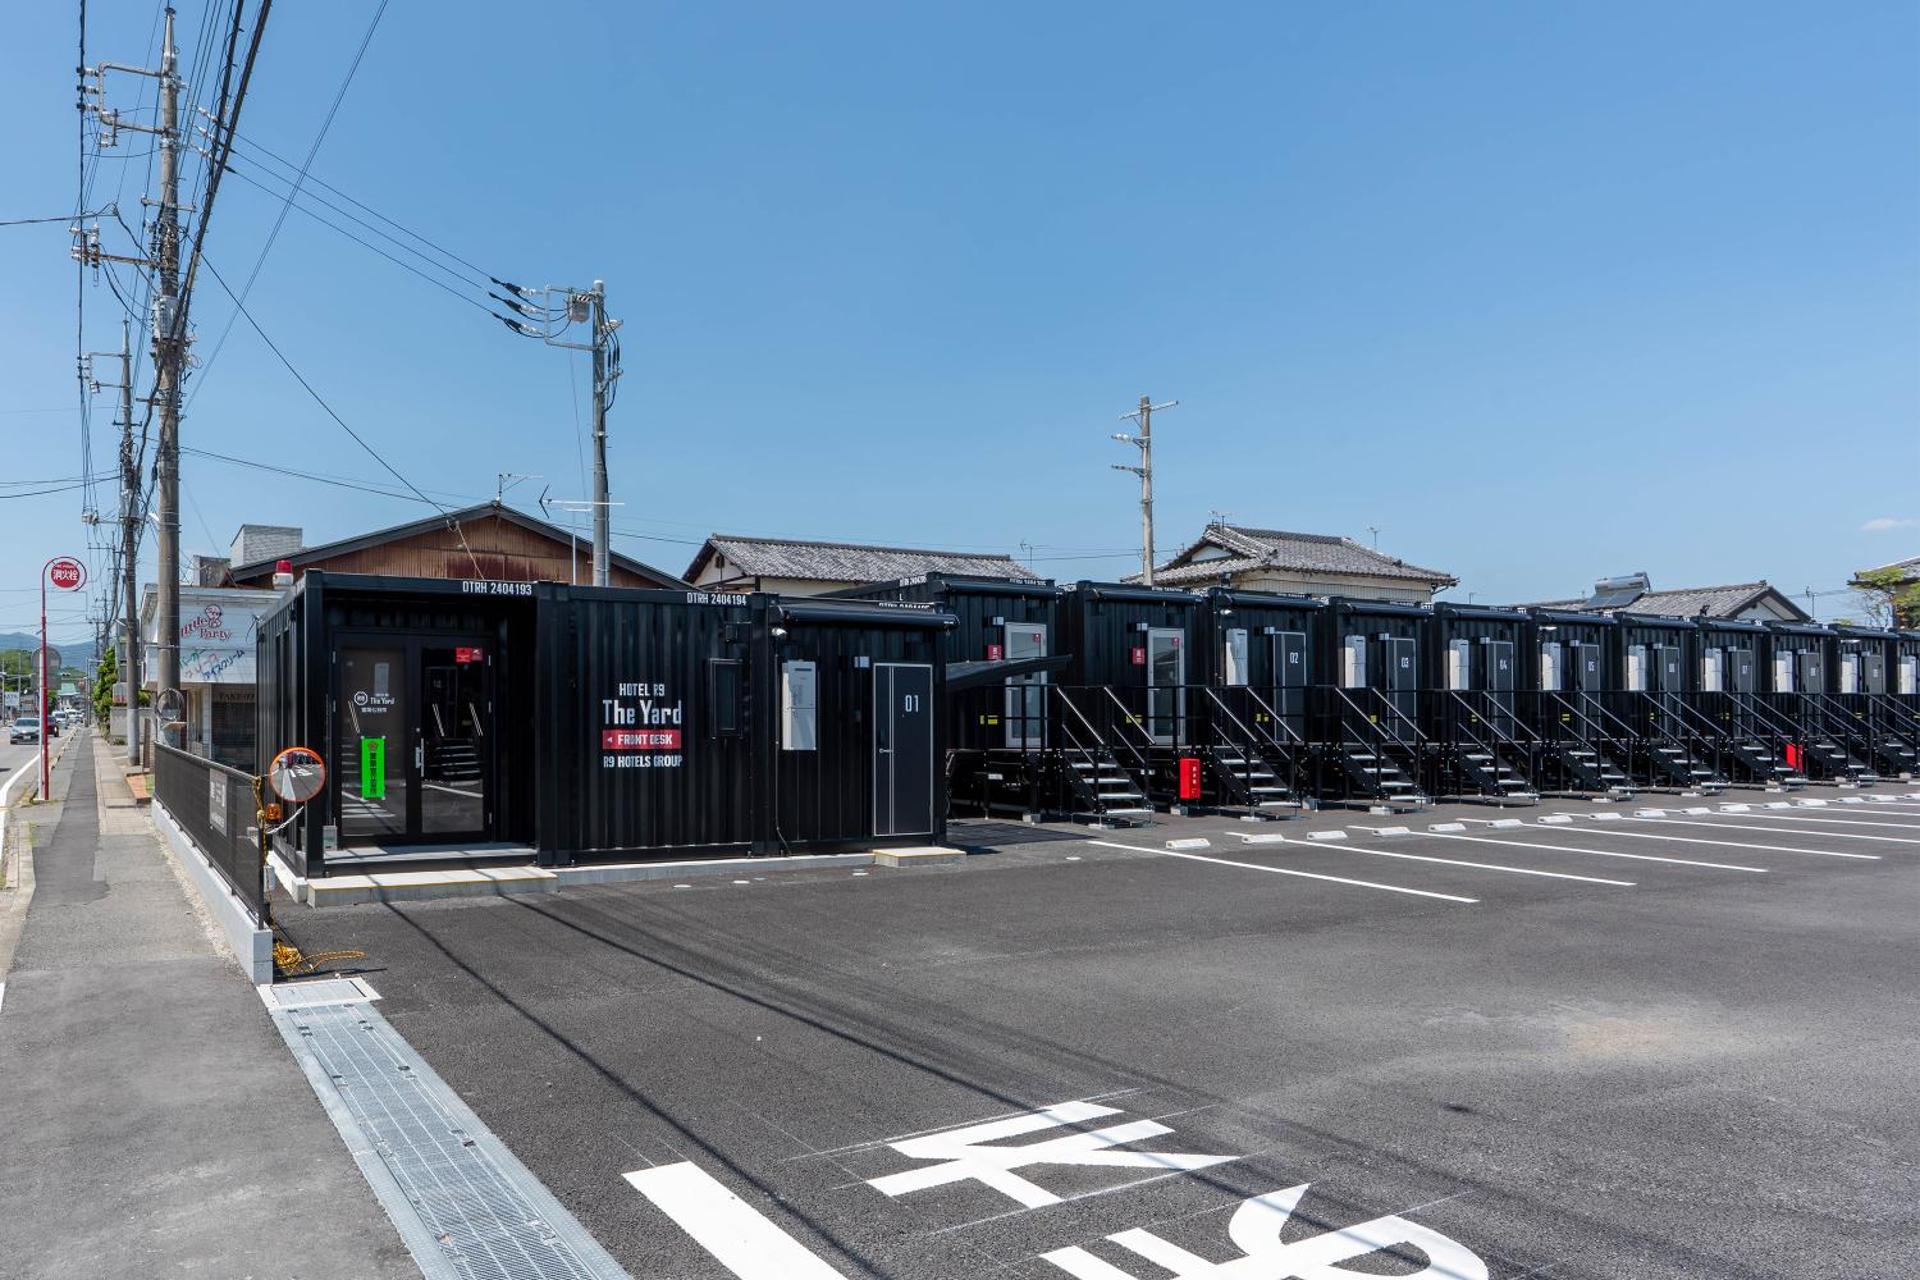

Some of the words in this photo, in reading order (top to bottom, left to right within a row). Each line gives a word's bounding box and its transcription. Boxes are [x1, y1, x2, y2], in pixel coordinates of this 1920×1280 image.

[53, 569, 79, 581] 消火栓
[462, 581, 487, 594] DTRH
[490, 582, 532, 596] 2404193
[686, 592, 709, 604] DTRH
[711, 593, 747, 606] 2404194
[1289, 651, 1299, 664] 02
[619, 682, 651, 696] HOTEL
[653, 683, 665, 697] R9
[905, 694, 919, 713] 01
[602, 699, 636, 725] The
[639, 699, 682, 725] Yard
[617, 734, 648, 745] FRONT
[649, 734, 673, 745] DESK
[603, 755, 615, 768] R9
[617, 755, 651, 768] HOTELS
[653, 754, 683, 767] GROUP
